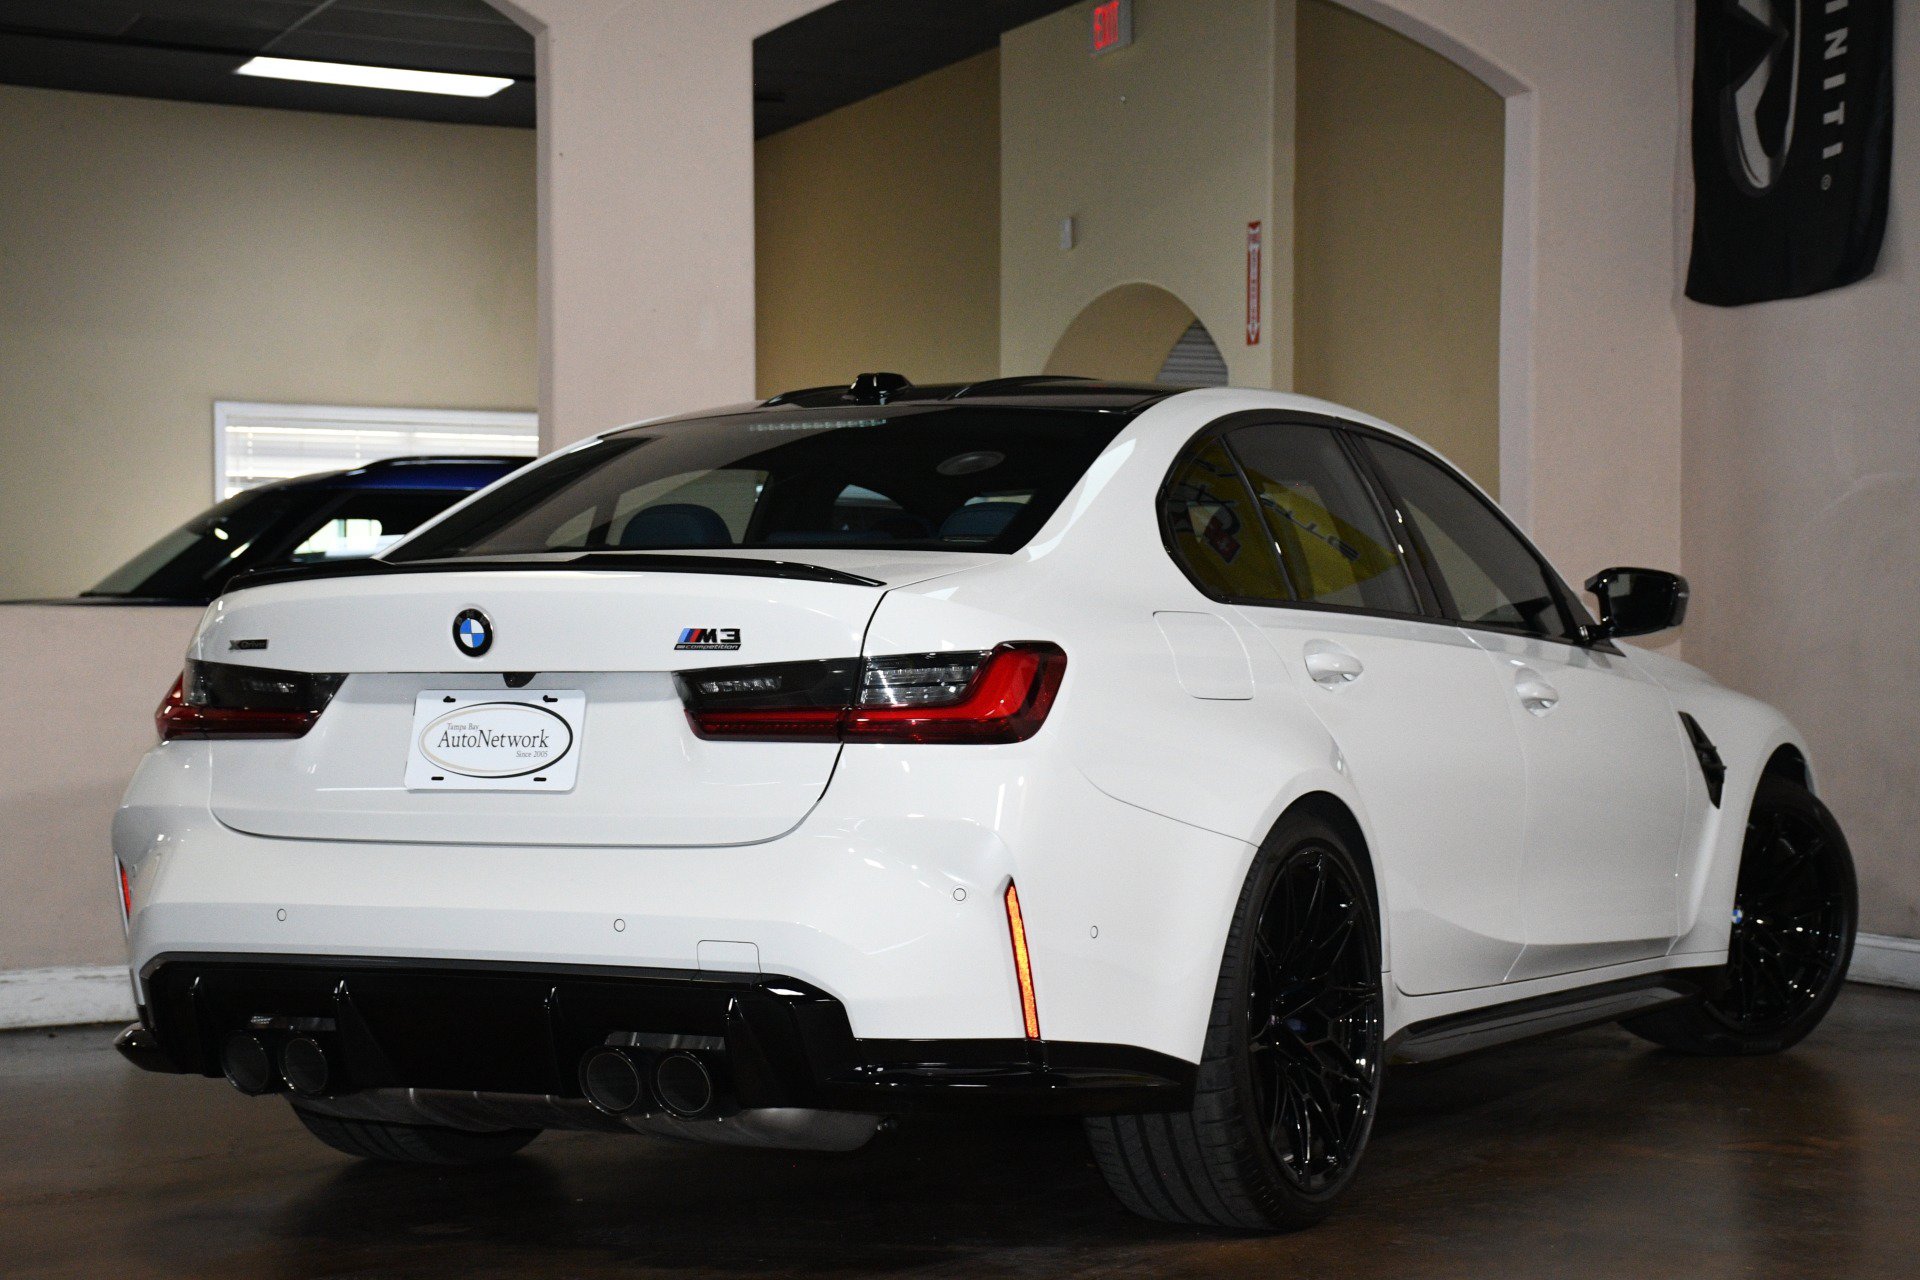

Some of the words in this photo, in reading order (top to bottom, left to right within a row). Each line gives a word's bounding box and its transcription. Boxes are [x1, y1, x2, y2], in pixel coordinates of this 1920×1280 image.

[697, 628, 741, 643] M3
[447, 722, 466, 732] Tampa
[468, 722, 480, 732] Bay
[437, 728, 550, 748] AutoNetwork
[516, 750, 532, 758] Since
[533, 750, 548, 758] 2005
